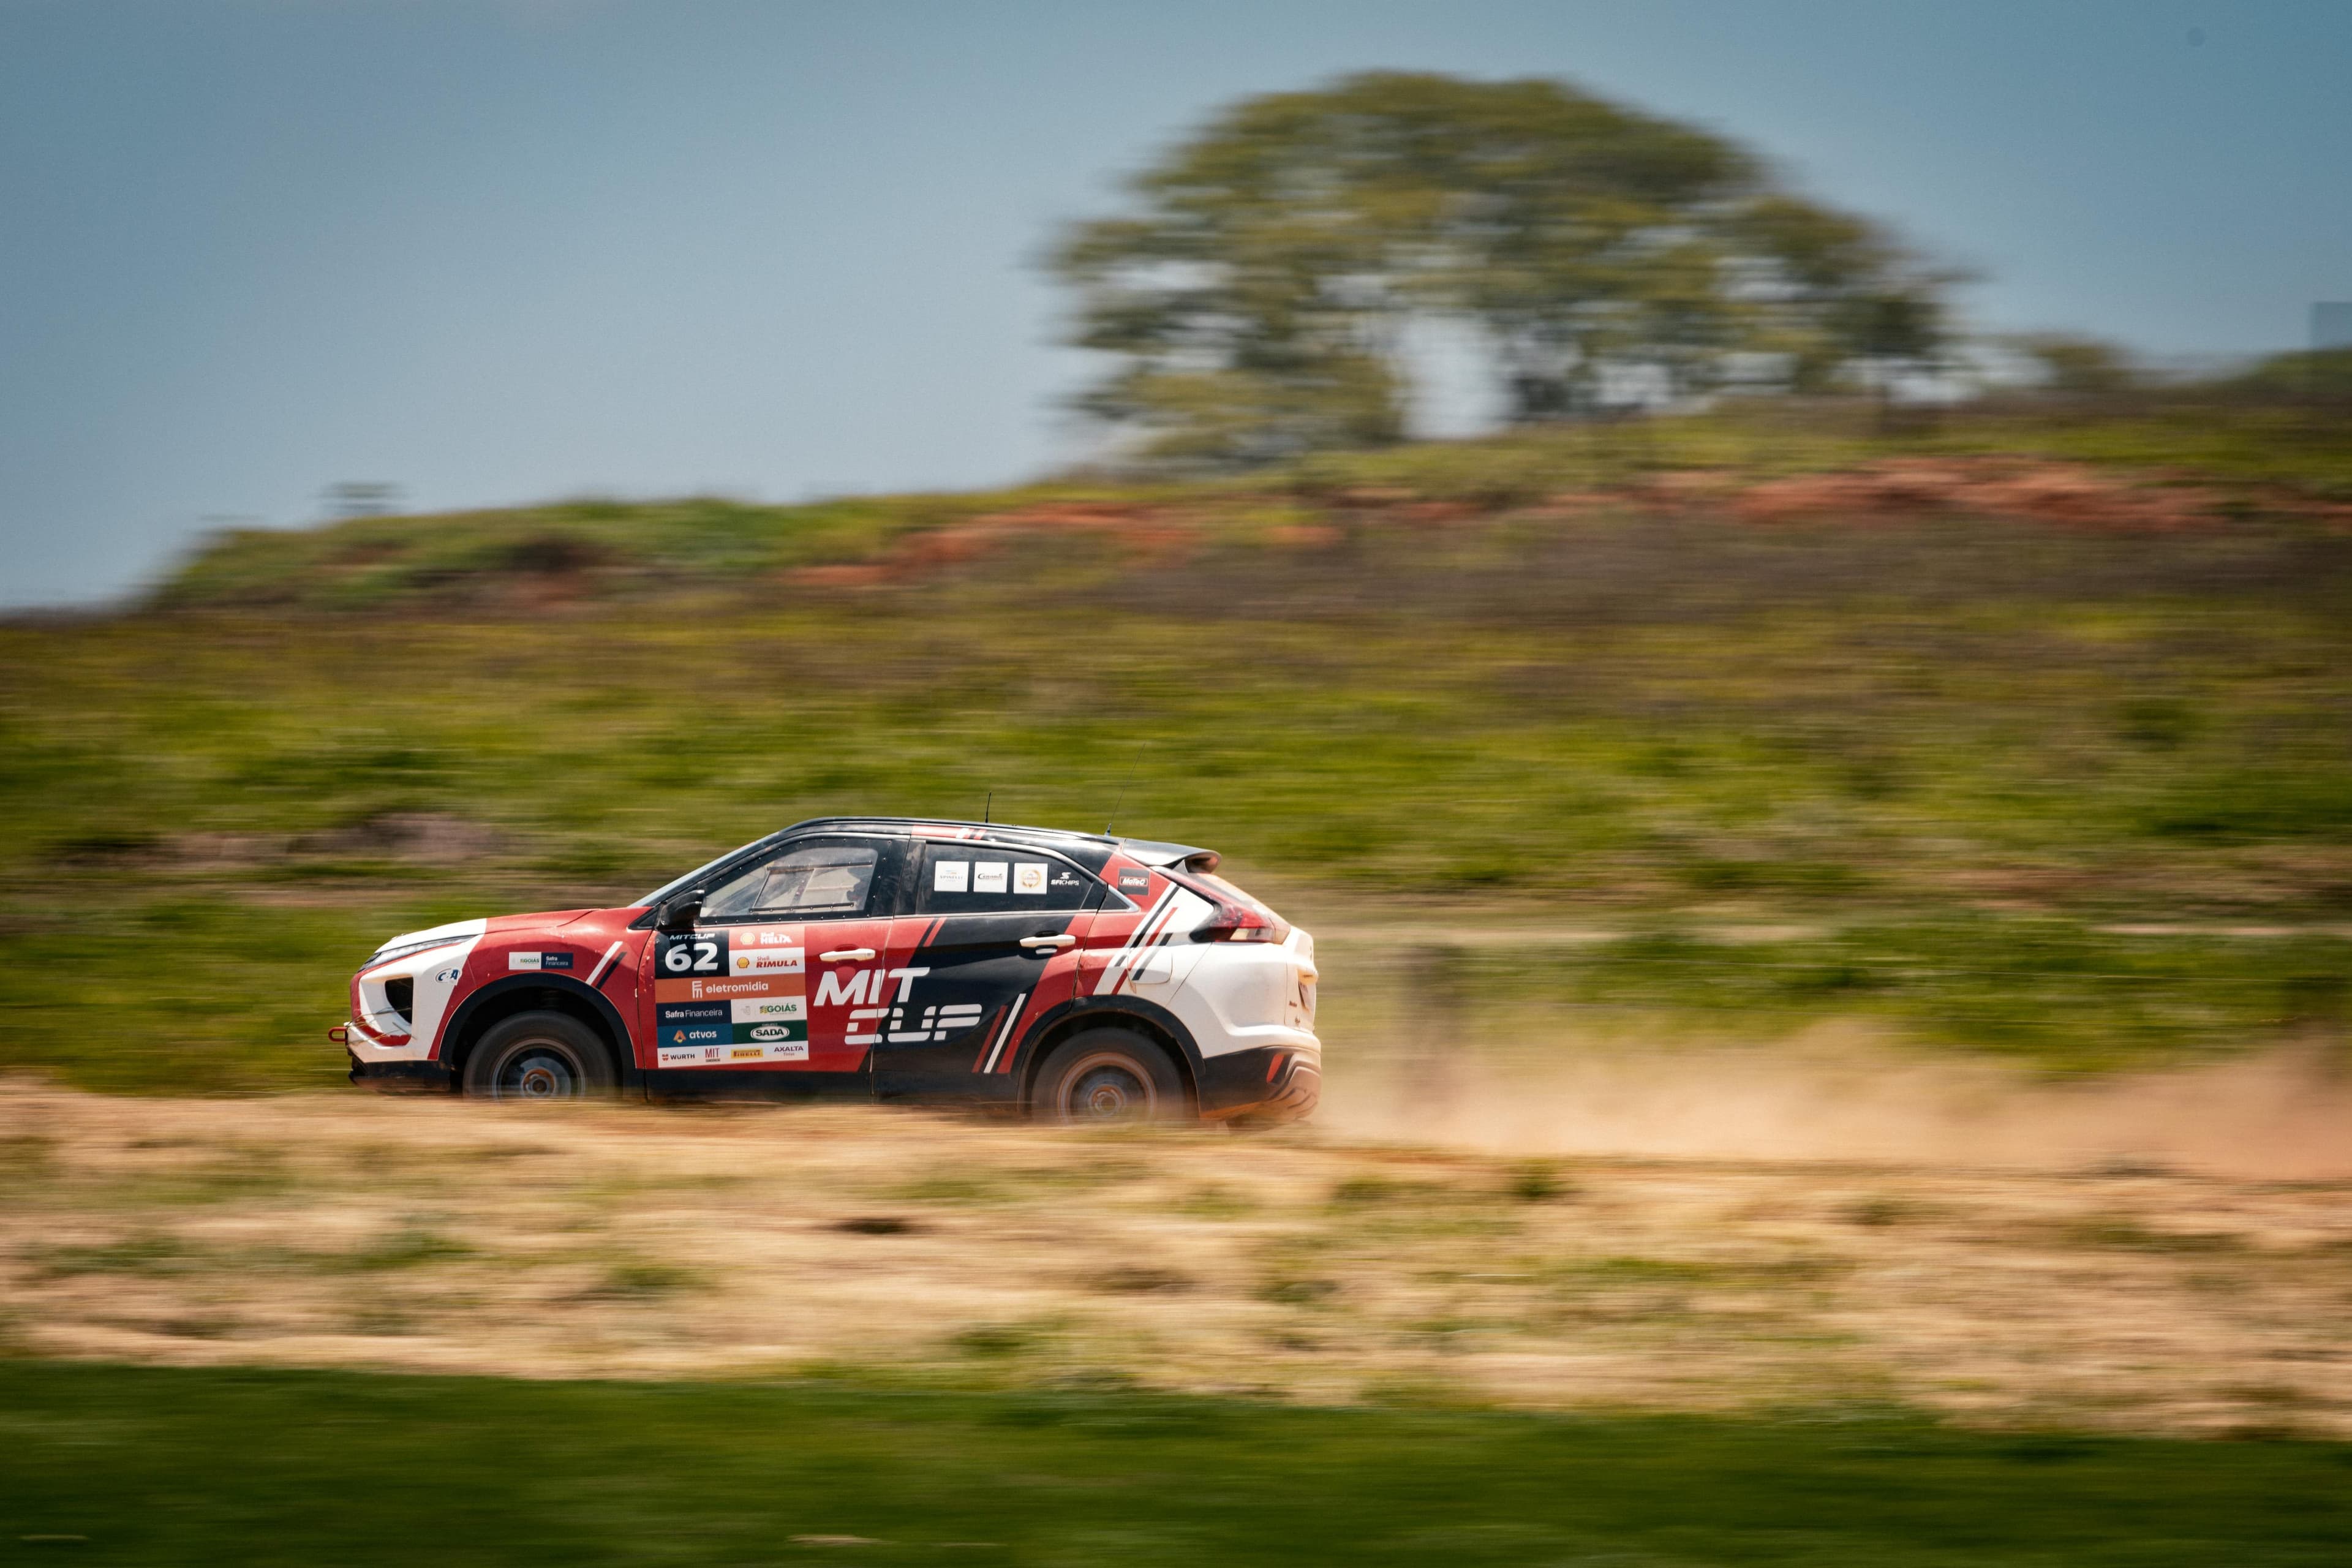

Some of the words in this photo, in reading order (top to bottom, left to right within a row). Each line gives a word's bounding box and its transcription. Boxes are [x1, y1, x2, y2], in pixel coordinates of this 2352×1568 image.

[760, 934, 793, 944] HELIX
[665, 942, 718, 972] 62
[756, 960, 797, 968] RIMULA
[706, 981, 769, 993] eletromidia
[813, 967, 930, 1006] MIT
[767, 1003, 797, 1012] GOIÁS
[665, 1010, 684, 1019] Safra
[685, 1008, 723, 1018] Financeira
[844, 1003, 982, 1045] CUP
[689, 1030, 717, 1039] atvos
[705, 1048, 720, 1058] MIT
[733, 1049, 760, 1058] PIRELLI
